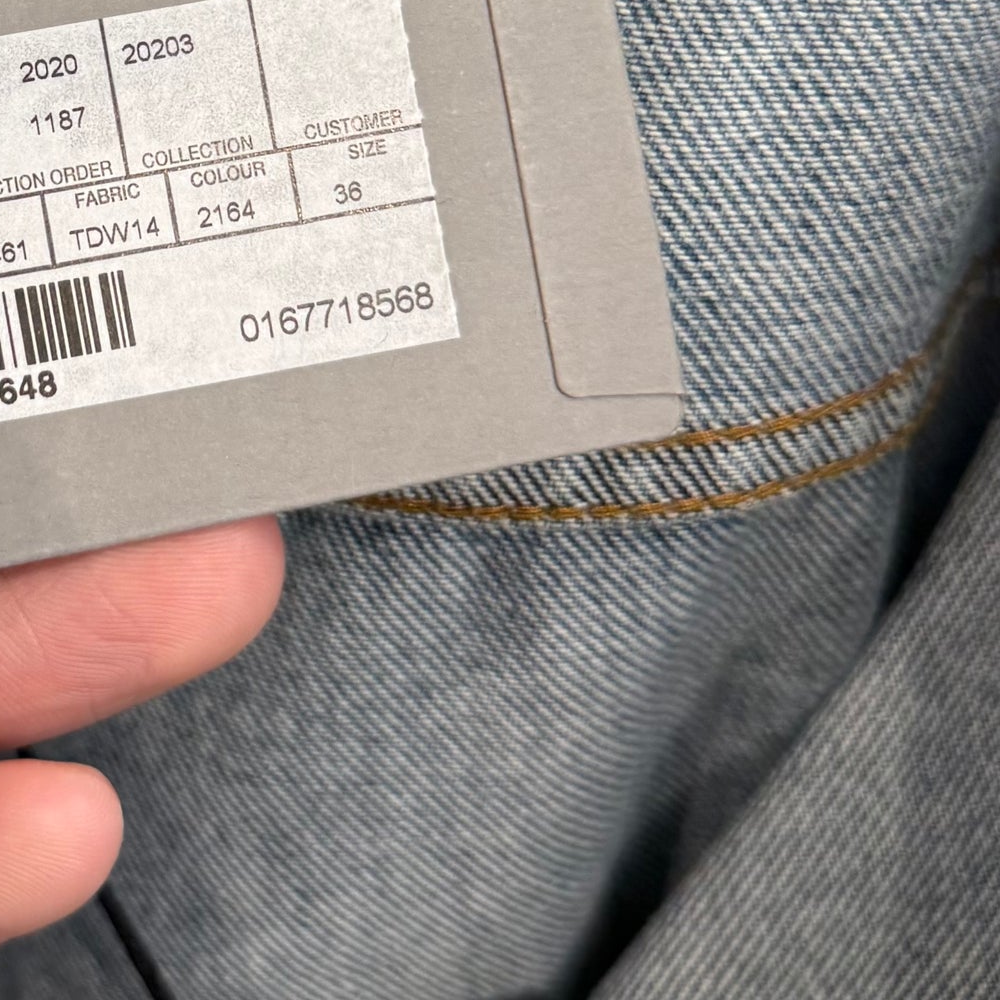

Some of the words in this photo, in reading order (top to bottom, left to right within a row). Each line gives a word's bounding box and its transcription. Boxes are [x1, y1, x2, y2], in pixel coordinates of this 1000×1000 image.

[122, 33, 195, 65] 20203
[20, 54, 78, 83] 2020
[30, 106, 85, 136] 1187
[304, 108, 404, 140] CUSTOMER
[142, 135, 255, 169] COLLECTION
[348, 139, 388, 160] SIZE
[50, 160, 114, 186] ORDER
[190, 160, 267, 188] COLOUR
[74, 182, 141, 209] FABRIC
[333, 181, 363, 205] 36
[197, 200, 256, 229] 2164
[69, 216, 161, 251] TDW14
[240, 282, 434, 342] 0167718568
